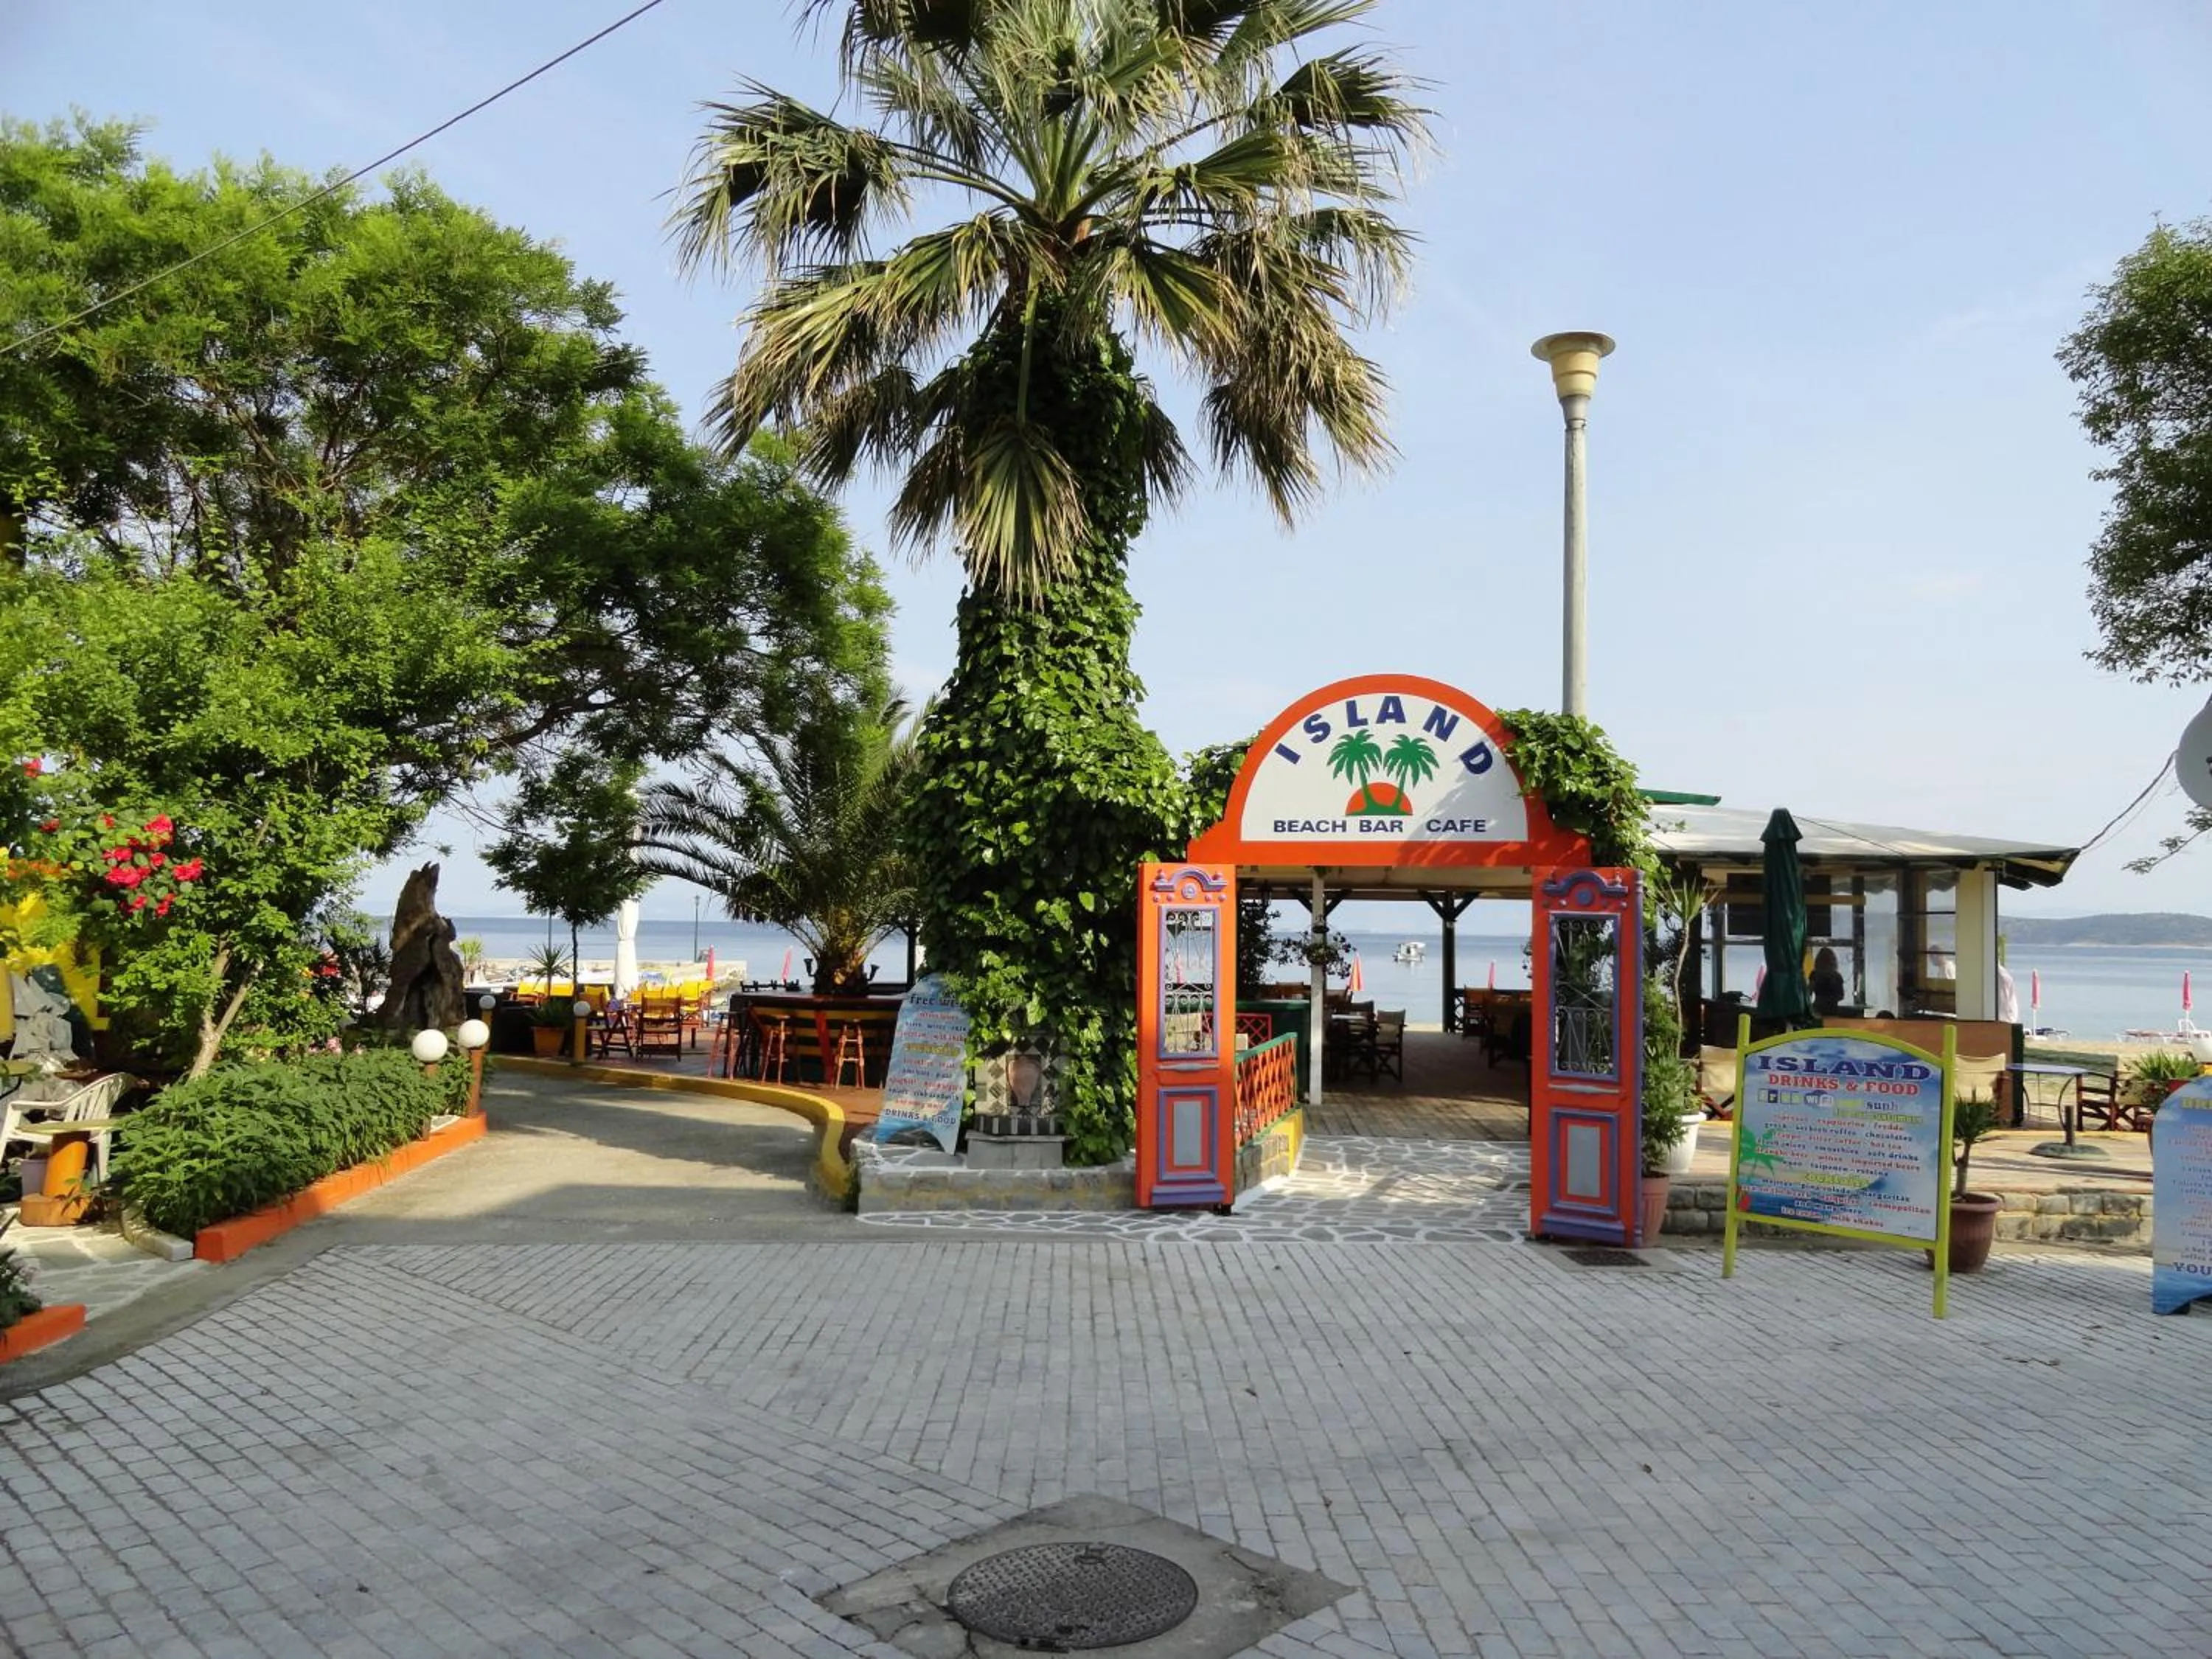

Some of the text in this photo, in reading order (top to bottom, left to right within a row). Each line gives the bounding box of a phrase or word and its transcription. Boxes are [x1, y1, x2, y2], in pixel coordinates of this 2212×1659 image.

[1275, 696, 1494, 776] ISLAND
[1273, 819, 1486, 833] BEACH BAR CAFE
[1758, 1055, 1931, 1080] ISLAND
[1769, 1074, 1920, 1096] DRINKS & FOOD
[885, 1108, 920, 1119] DRINKS
